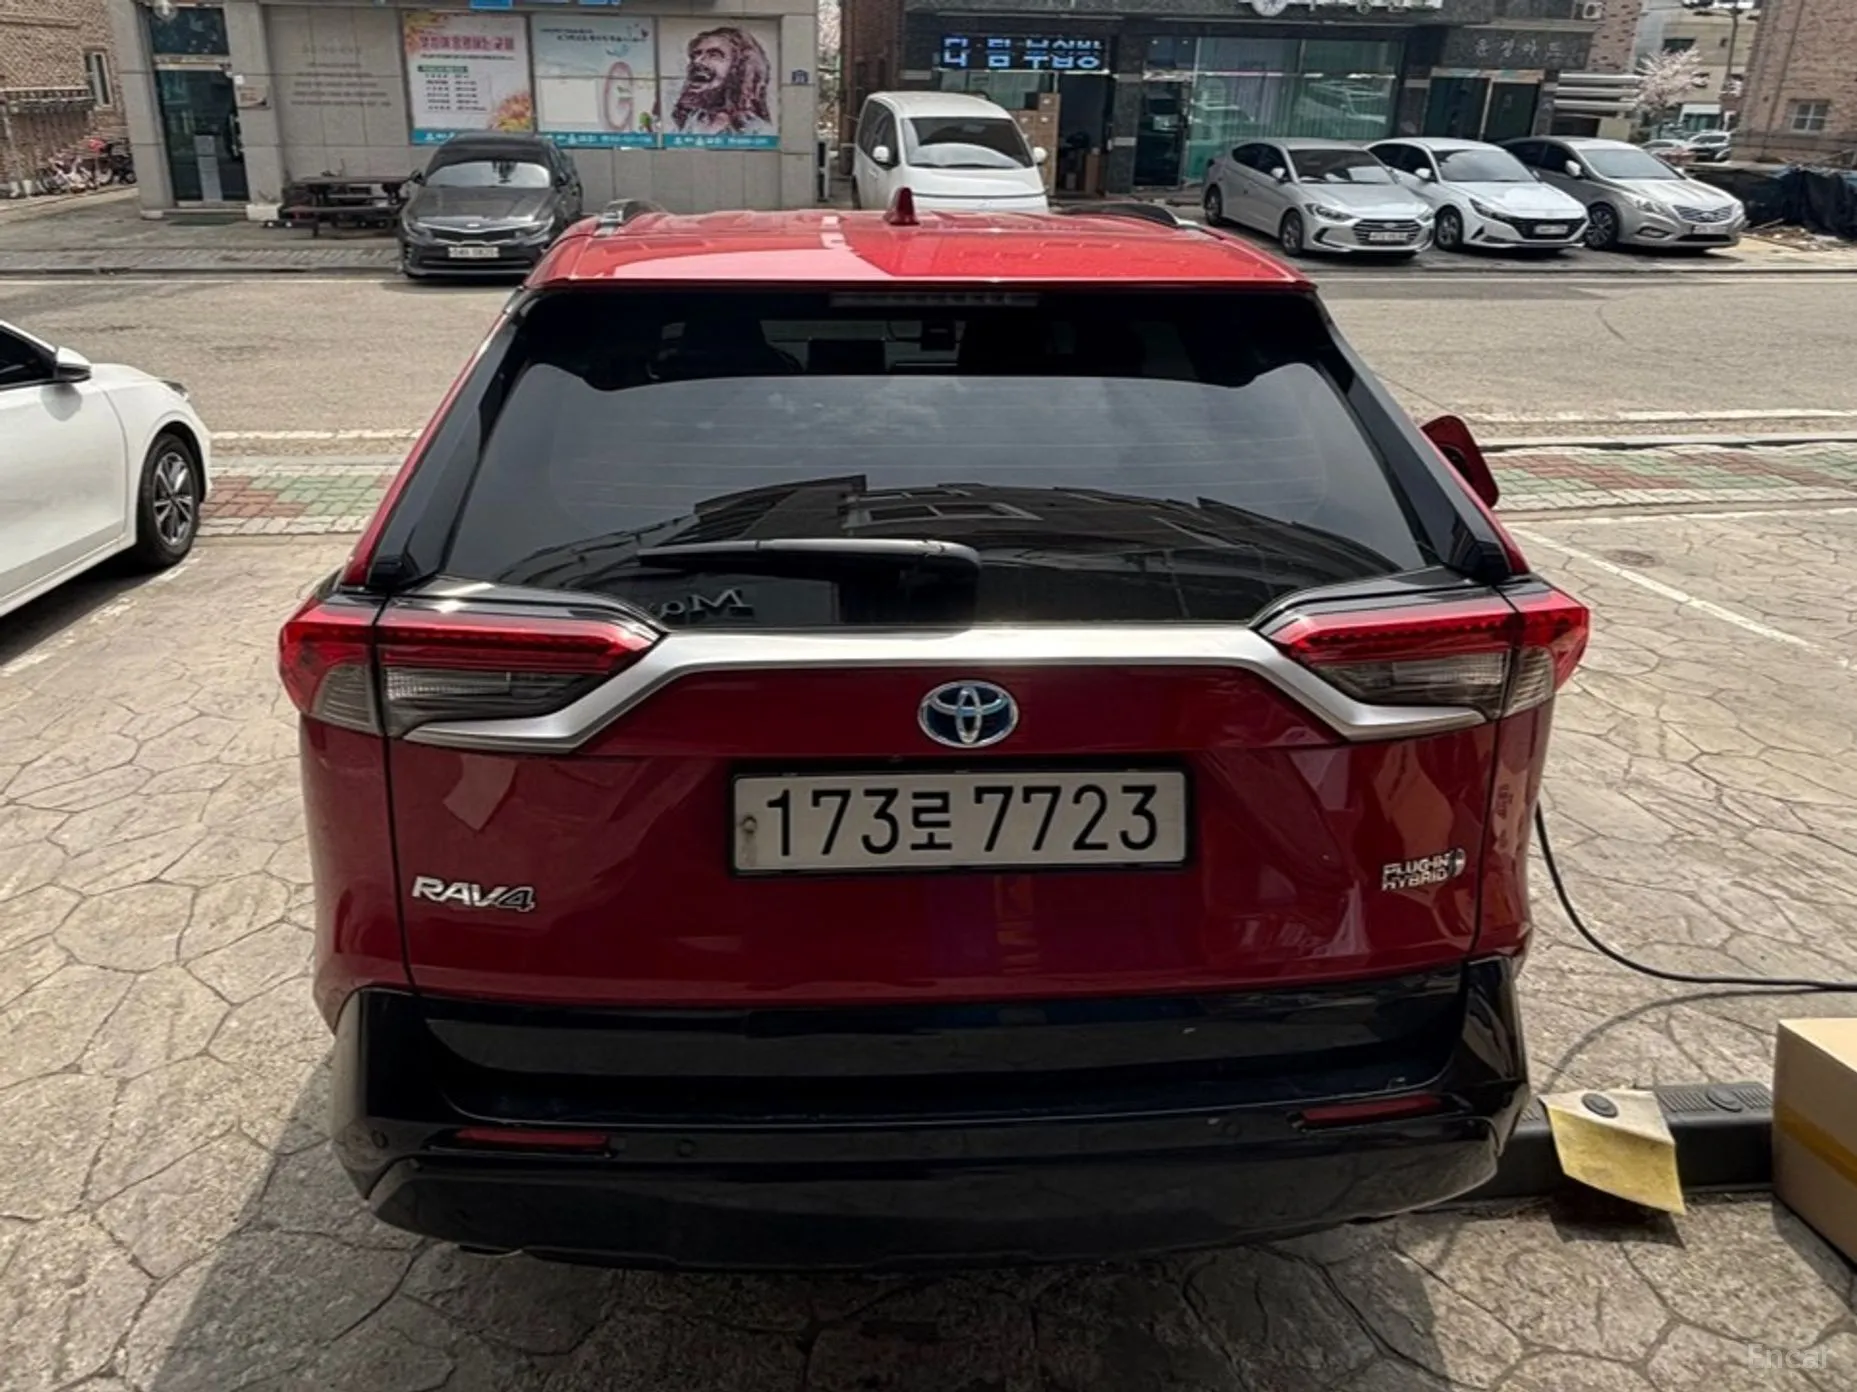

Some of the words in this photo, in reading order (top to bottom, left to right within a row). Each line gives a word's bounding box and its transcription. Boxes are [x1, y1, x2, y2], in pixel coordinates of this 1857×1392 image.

[766, 787, 953, 857] 173로
[973, 784, 1158, 853] 7723
[411, 875, 536, 912] RAV4
[1381, 867, 1449, 891] HYBRID
